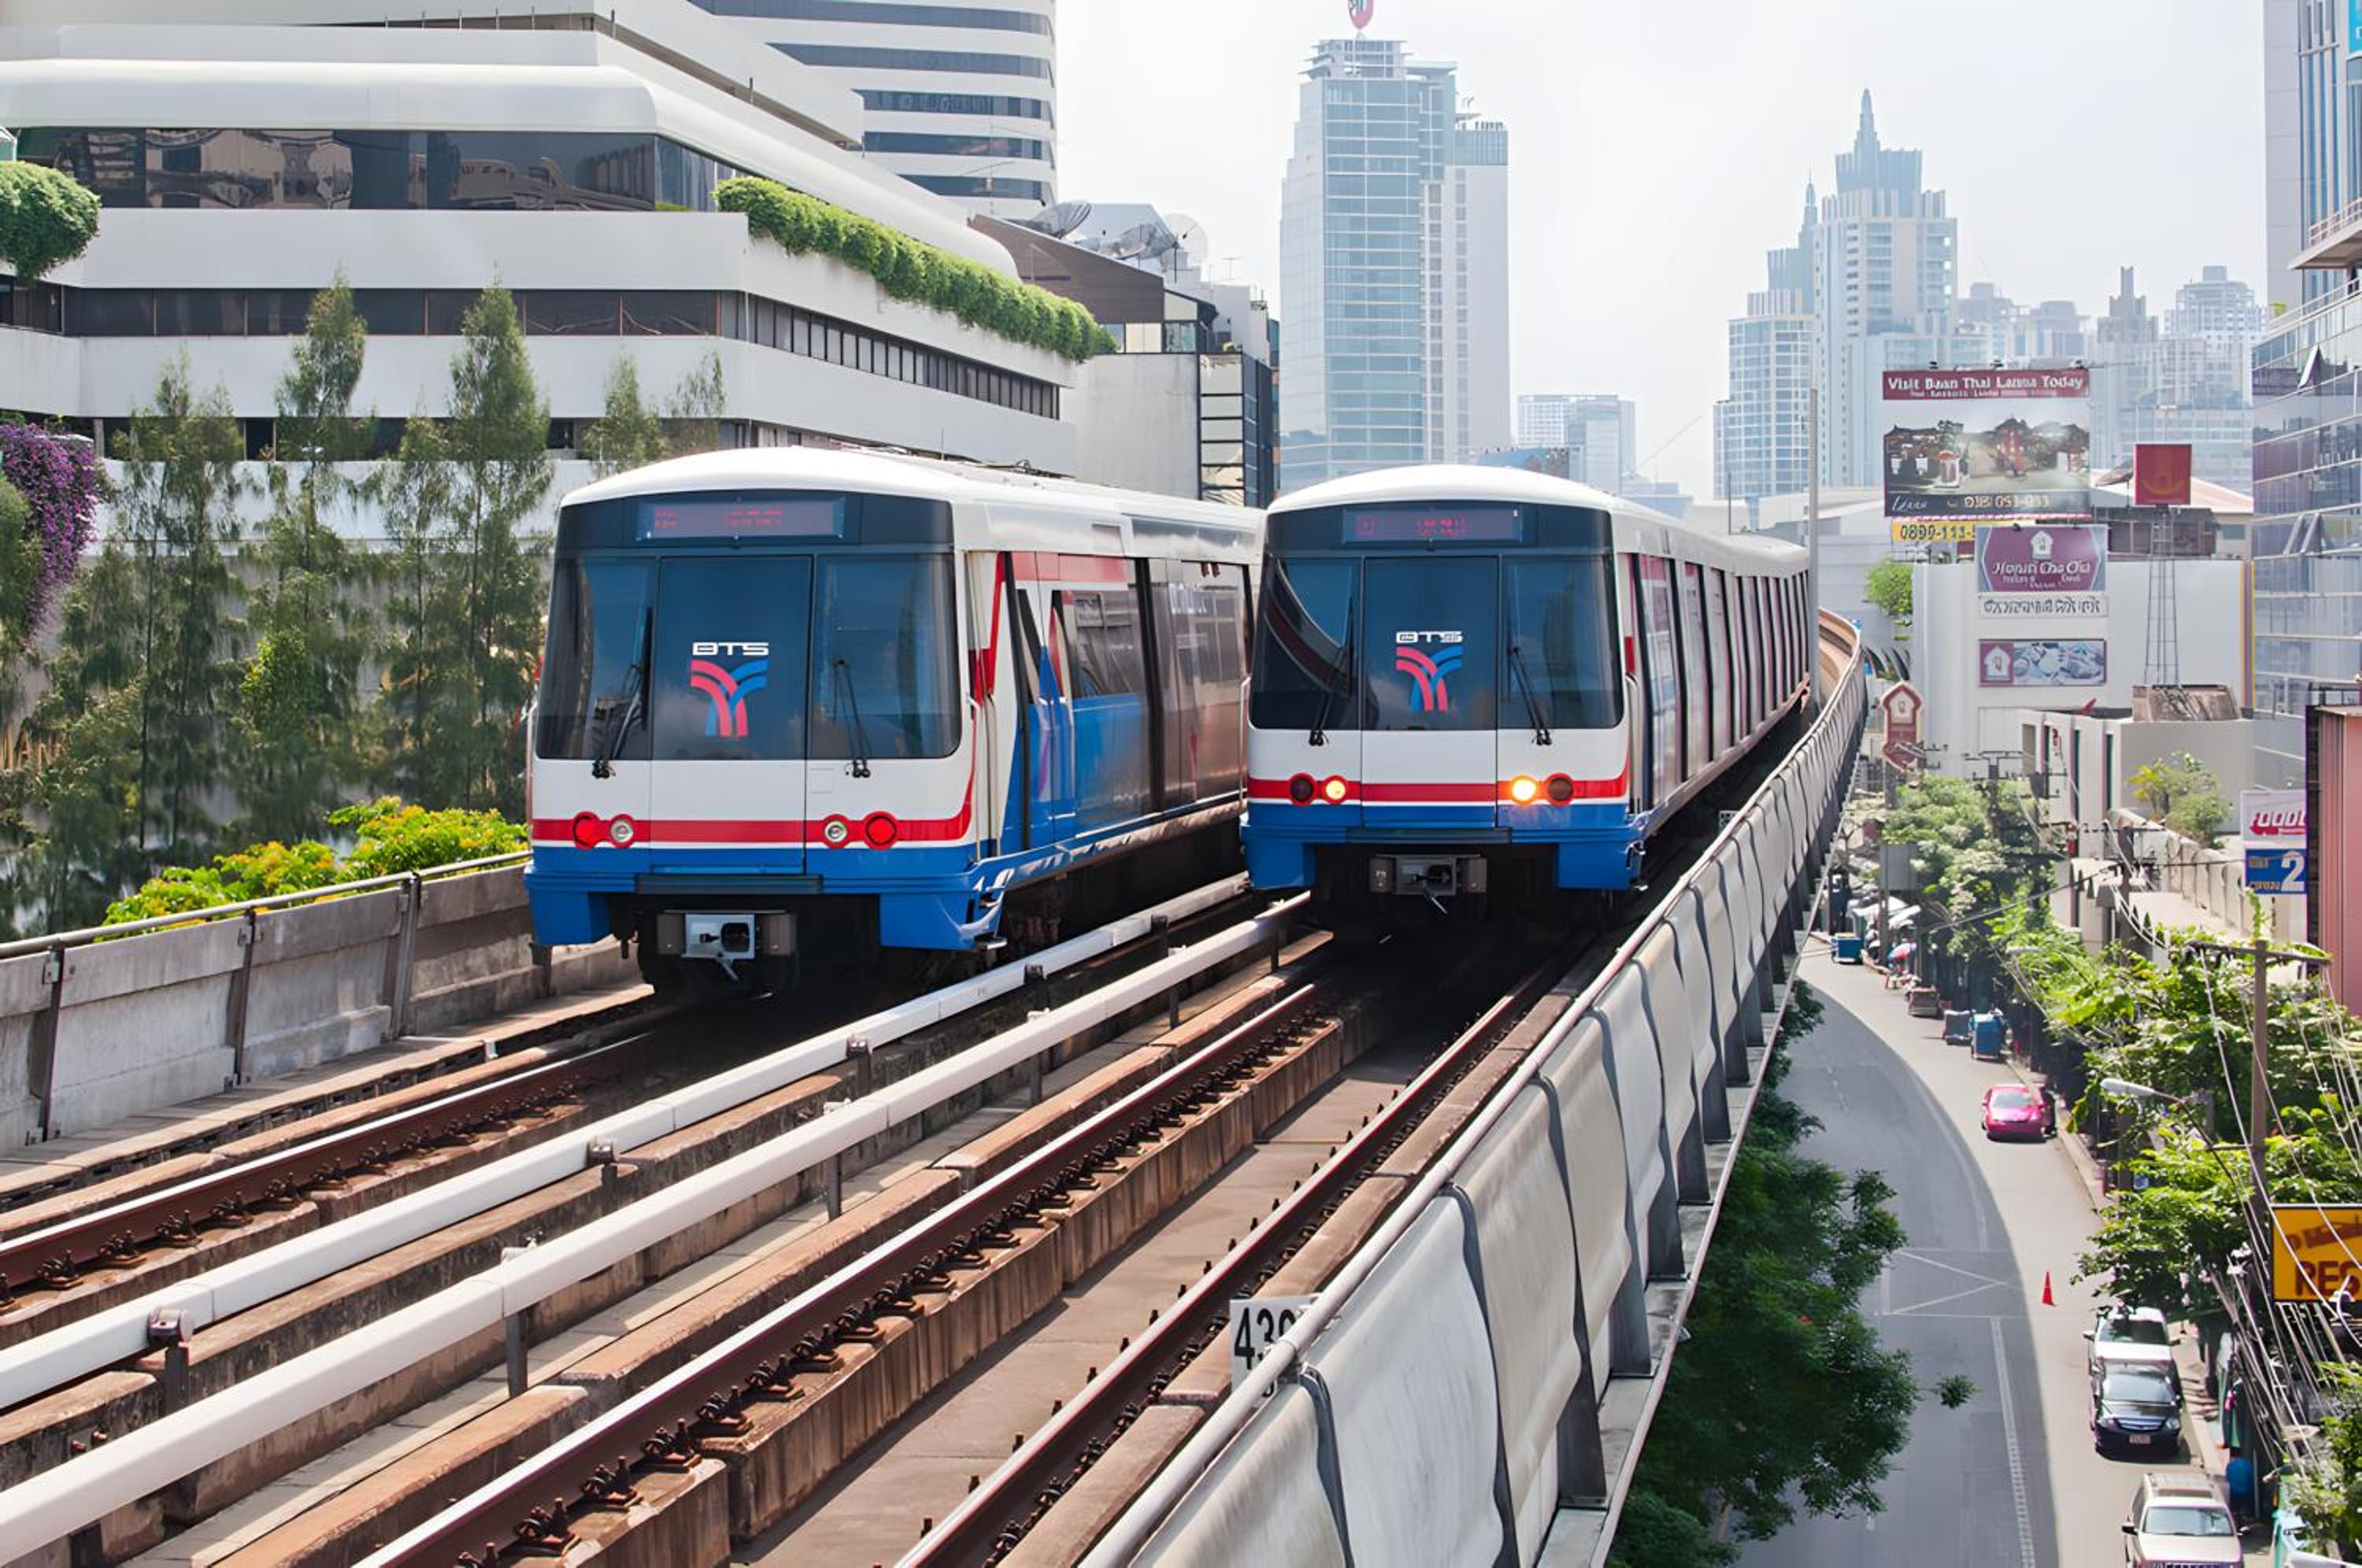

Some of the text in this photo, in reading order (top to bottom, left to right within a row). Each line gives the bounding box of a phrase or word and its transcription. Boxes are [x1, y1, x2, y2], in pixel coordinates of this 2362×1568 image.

[2041, 375, 2084, 390] Today
[1396, 631, 1464, 643] BTS
[692, 642, 769, 656] BTS
[2282, 851, 2305, 892] 2
